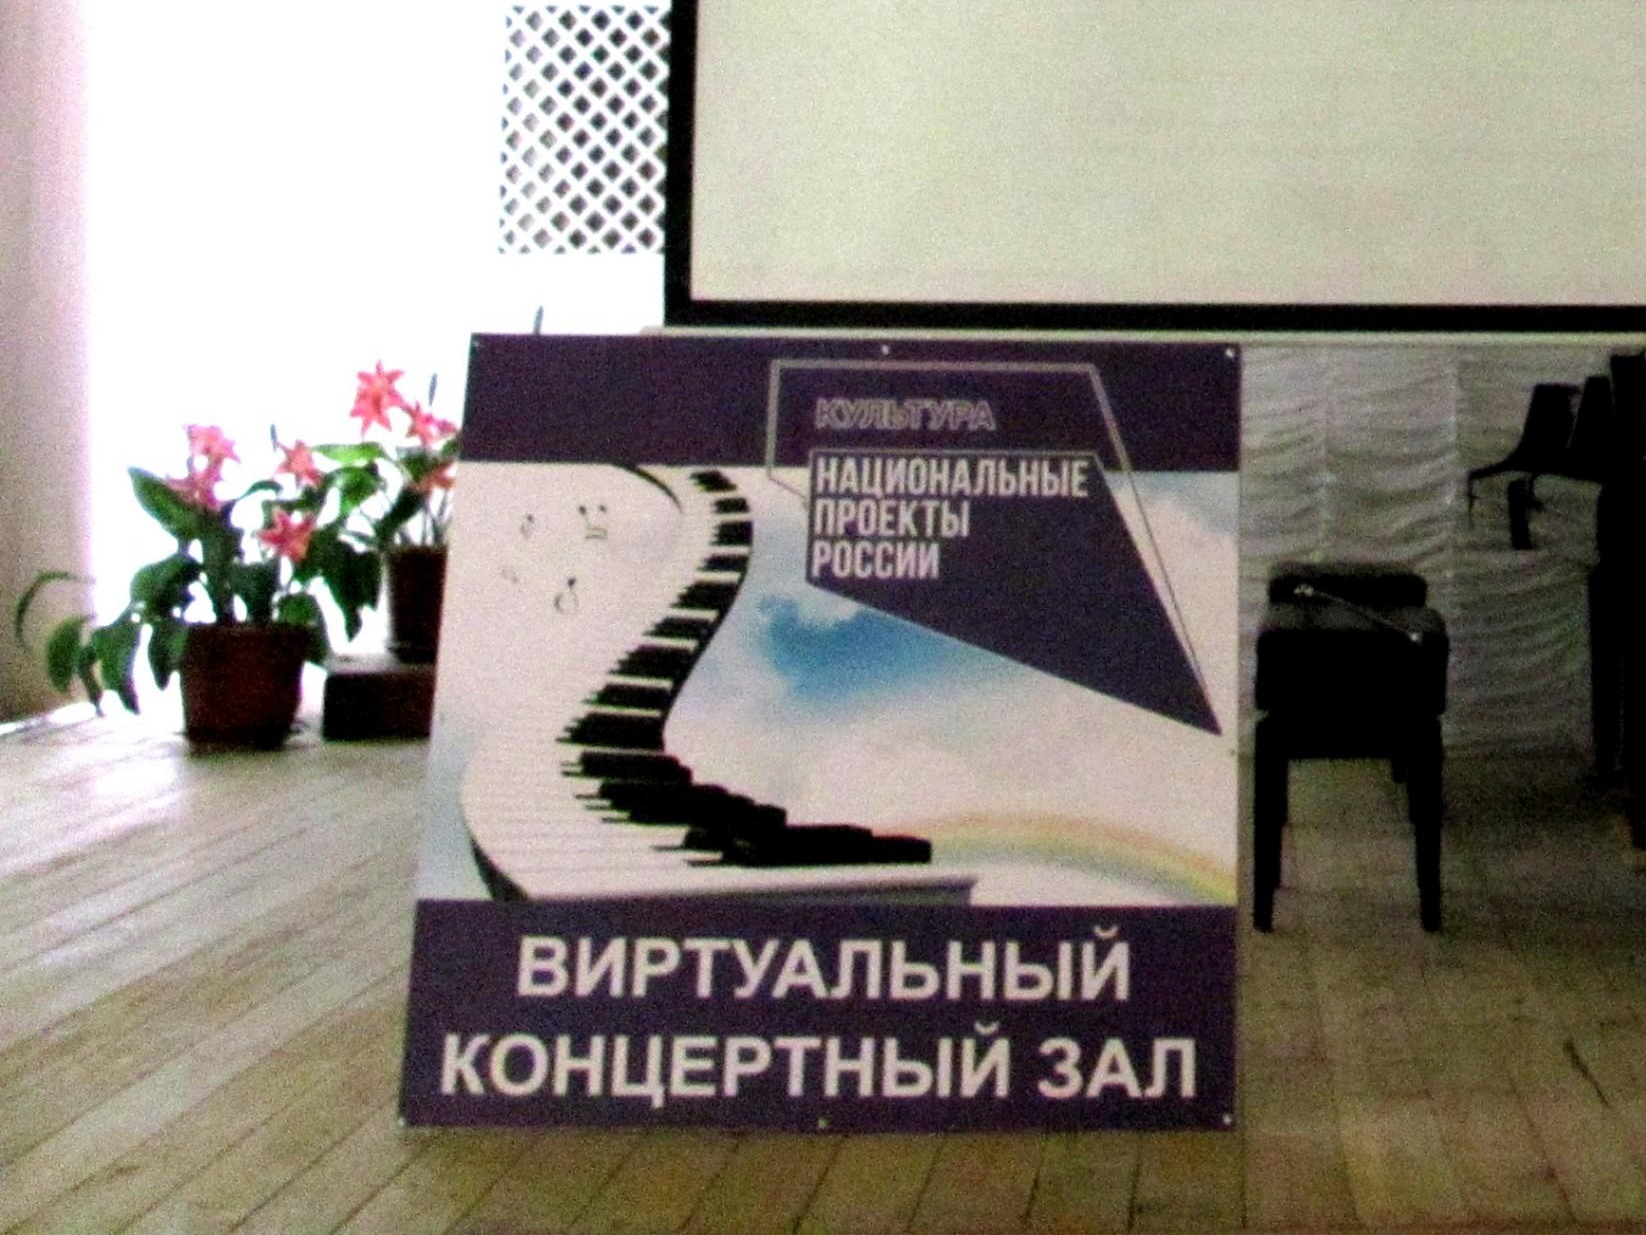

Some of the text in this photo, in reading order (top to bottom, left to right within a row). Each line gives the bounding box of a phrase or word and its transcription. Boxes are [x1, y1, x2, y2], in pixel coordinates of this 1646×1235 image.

[815, 397, 996, 431] КУЛЬТУРА
[816, 456, 1089, 499] НАЦИОНАЛЬНЫЕ
[814, 499, 969, 539] ПРОЕКТЫ
[812, 540, 940, 580] РОССИИ
[517, 926, 1130, 1002] ВИРТУАЛЬНЫЙ
[440, 1021, 1196, 1108] КОНЦЕРТНЫЙ ЗАЛ
